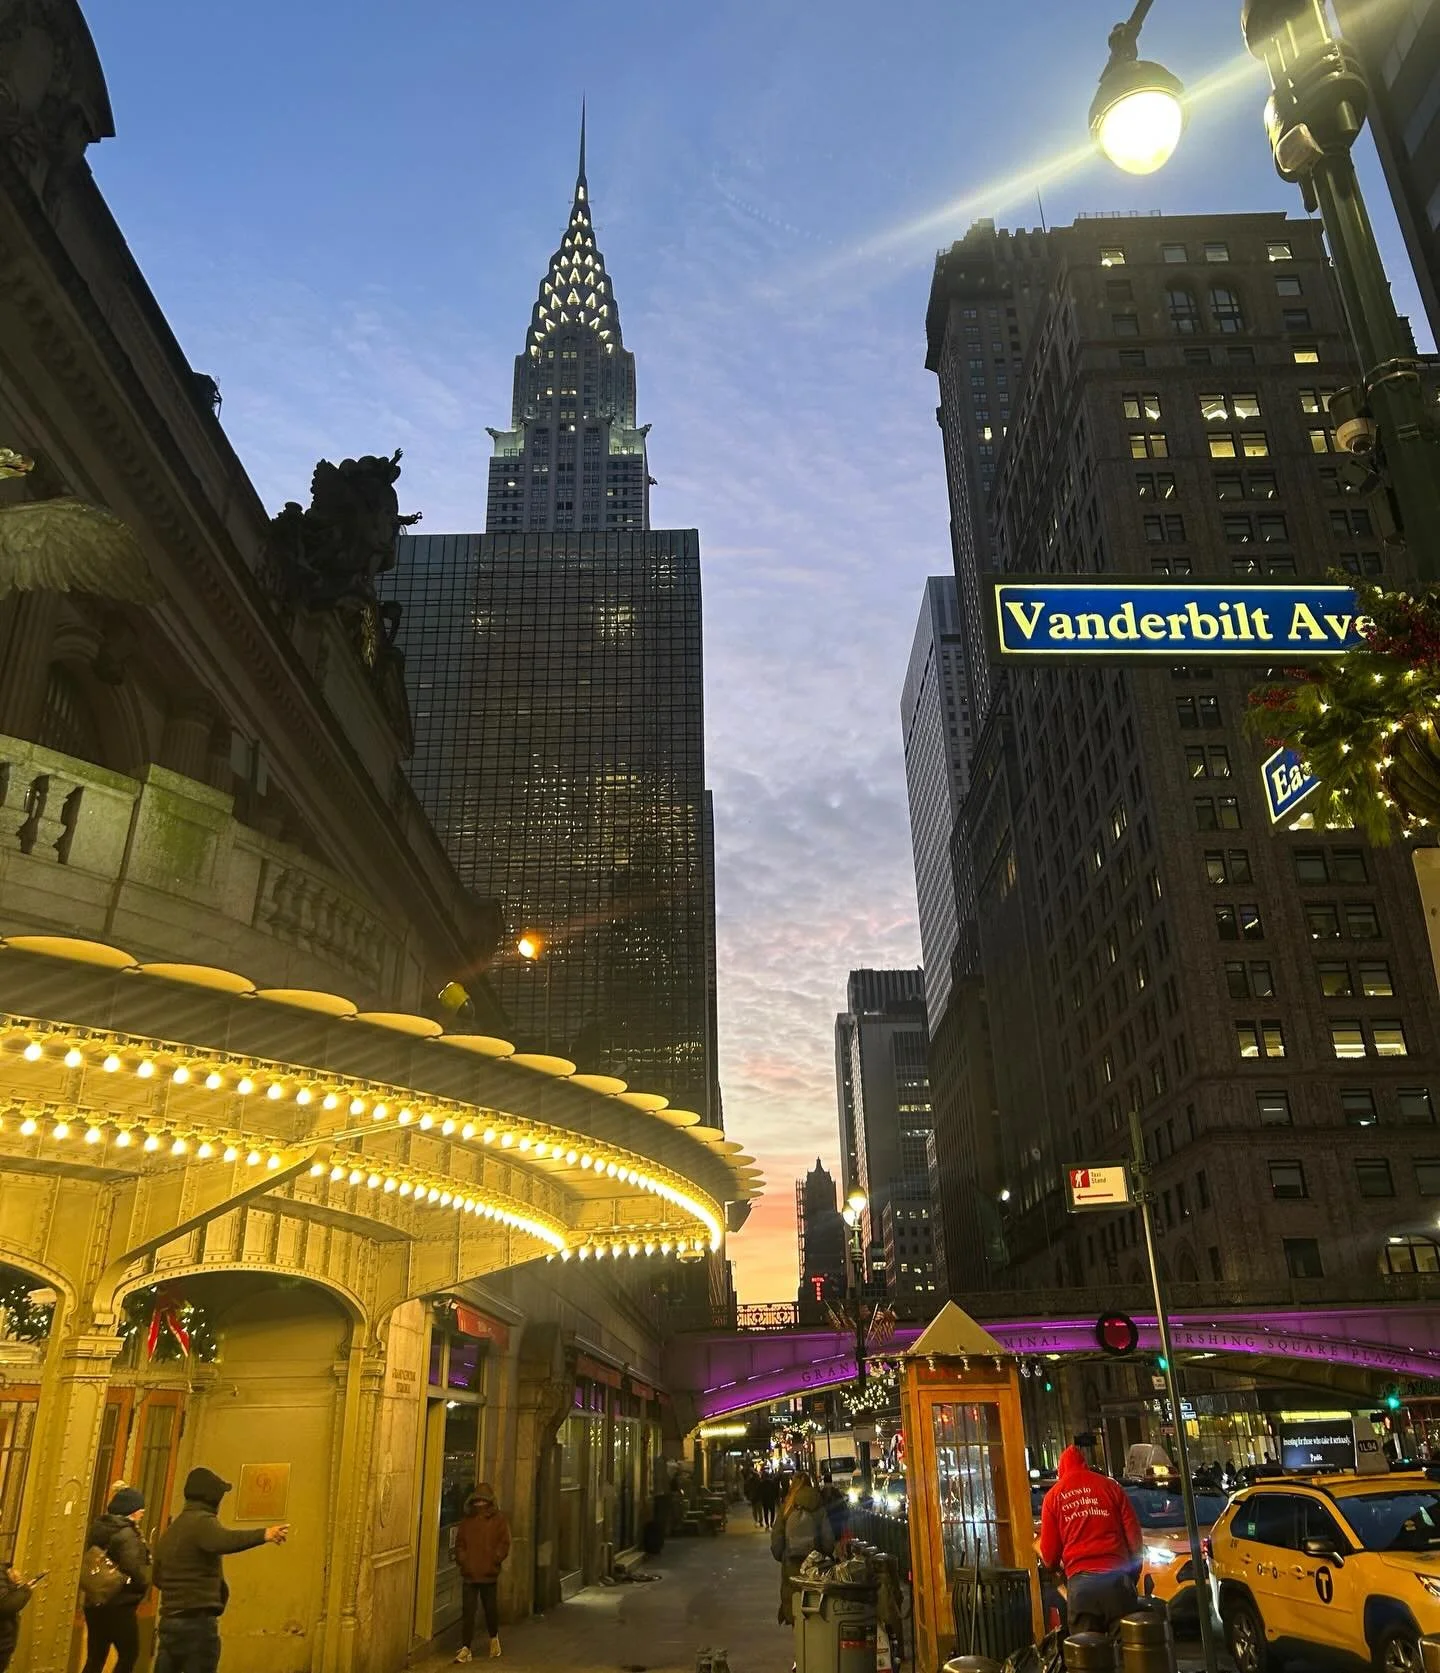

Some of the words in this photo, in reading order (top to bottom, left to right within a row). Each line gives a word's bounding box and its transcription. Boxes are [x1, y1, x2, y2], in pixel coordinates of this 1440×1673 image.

[1005, 601, 1274, 641] Vanderbilt
[1003, 1335, 1061, 1348] MINAL
[1174, 1331, 1256, 1348] ERSHING
[1268, 1338, 1339, 1356] SQUARE
[1352, 1349, 1410, 1367] PLAZA
[1360, 1442, 1377, 1451] 1L94
[1062, 1497, 1099, 1511] everything
[1319, 1573, 1329, 1599] T
